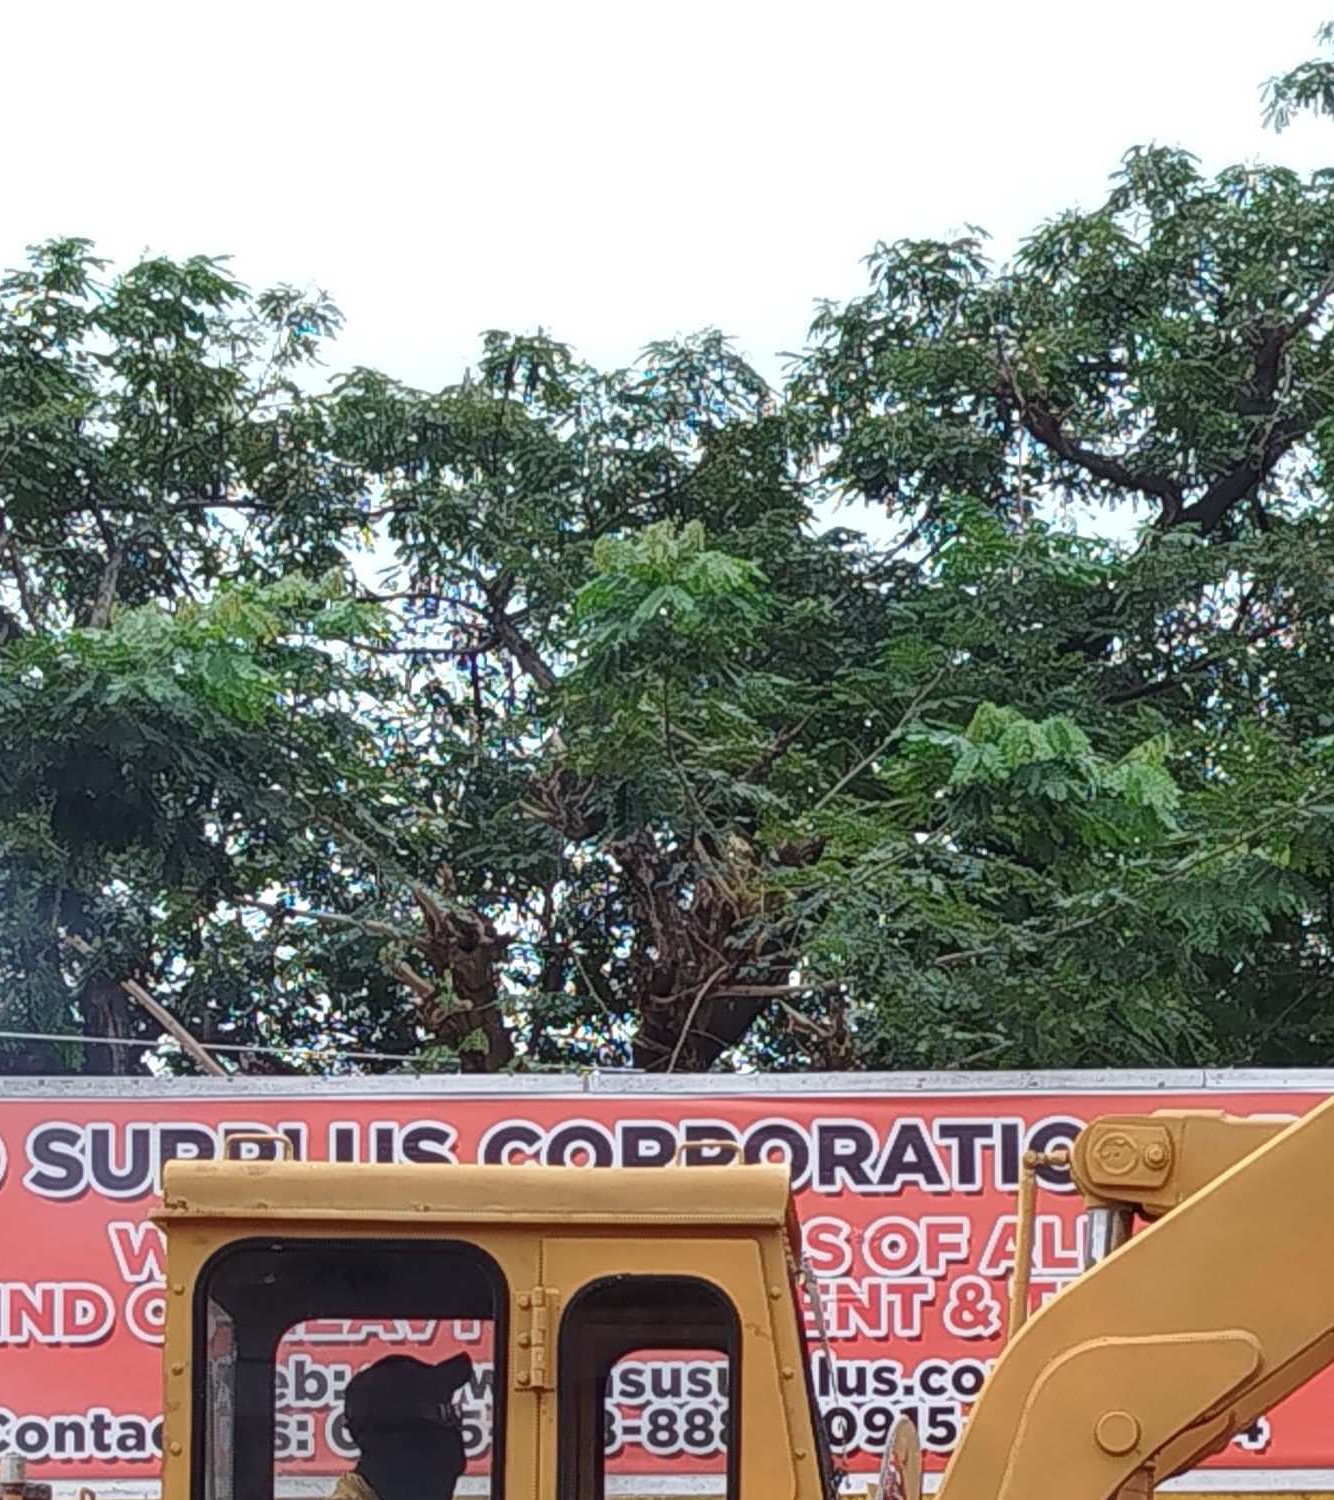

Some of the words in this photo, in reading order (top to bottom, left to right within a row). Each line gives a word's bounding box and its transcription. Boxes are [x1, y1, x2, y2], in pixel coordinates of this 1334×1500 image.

[482, 1123, 1075, 1190] CORPORATIO
[867, 1219, 970, 1272] OF
[983, 1219, 1087, 1271] AL
[948, 1281, 997, 1333] &
